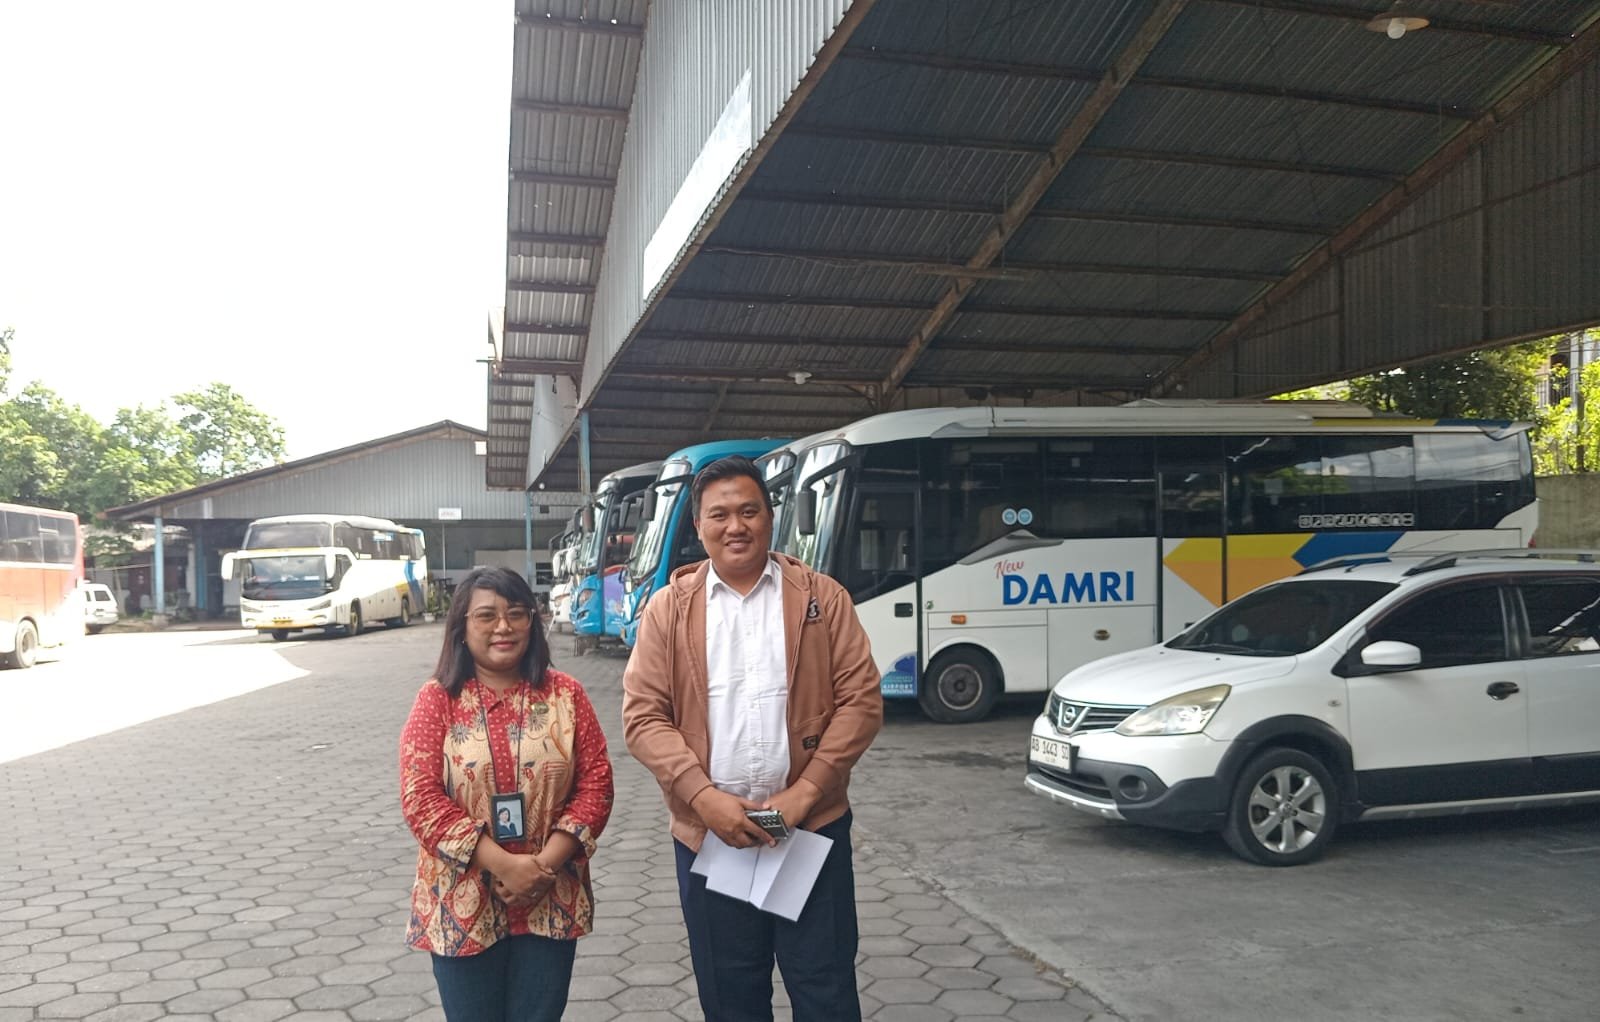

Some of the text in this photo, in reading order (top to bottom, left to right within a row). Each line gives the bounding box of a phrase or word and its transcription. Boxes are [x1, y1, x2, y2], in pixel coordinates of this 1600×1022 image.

[994, 560, 1024, 579] New
[1003, 571, 1134, 605] DAMRI
[1042, 740, 1058, 757] 1443
